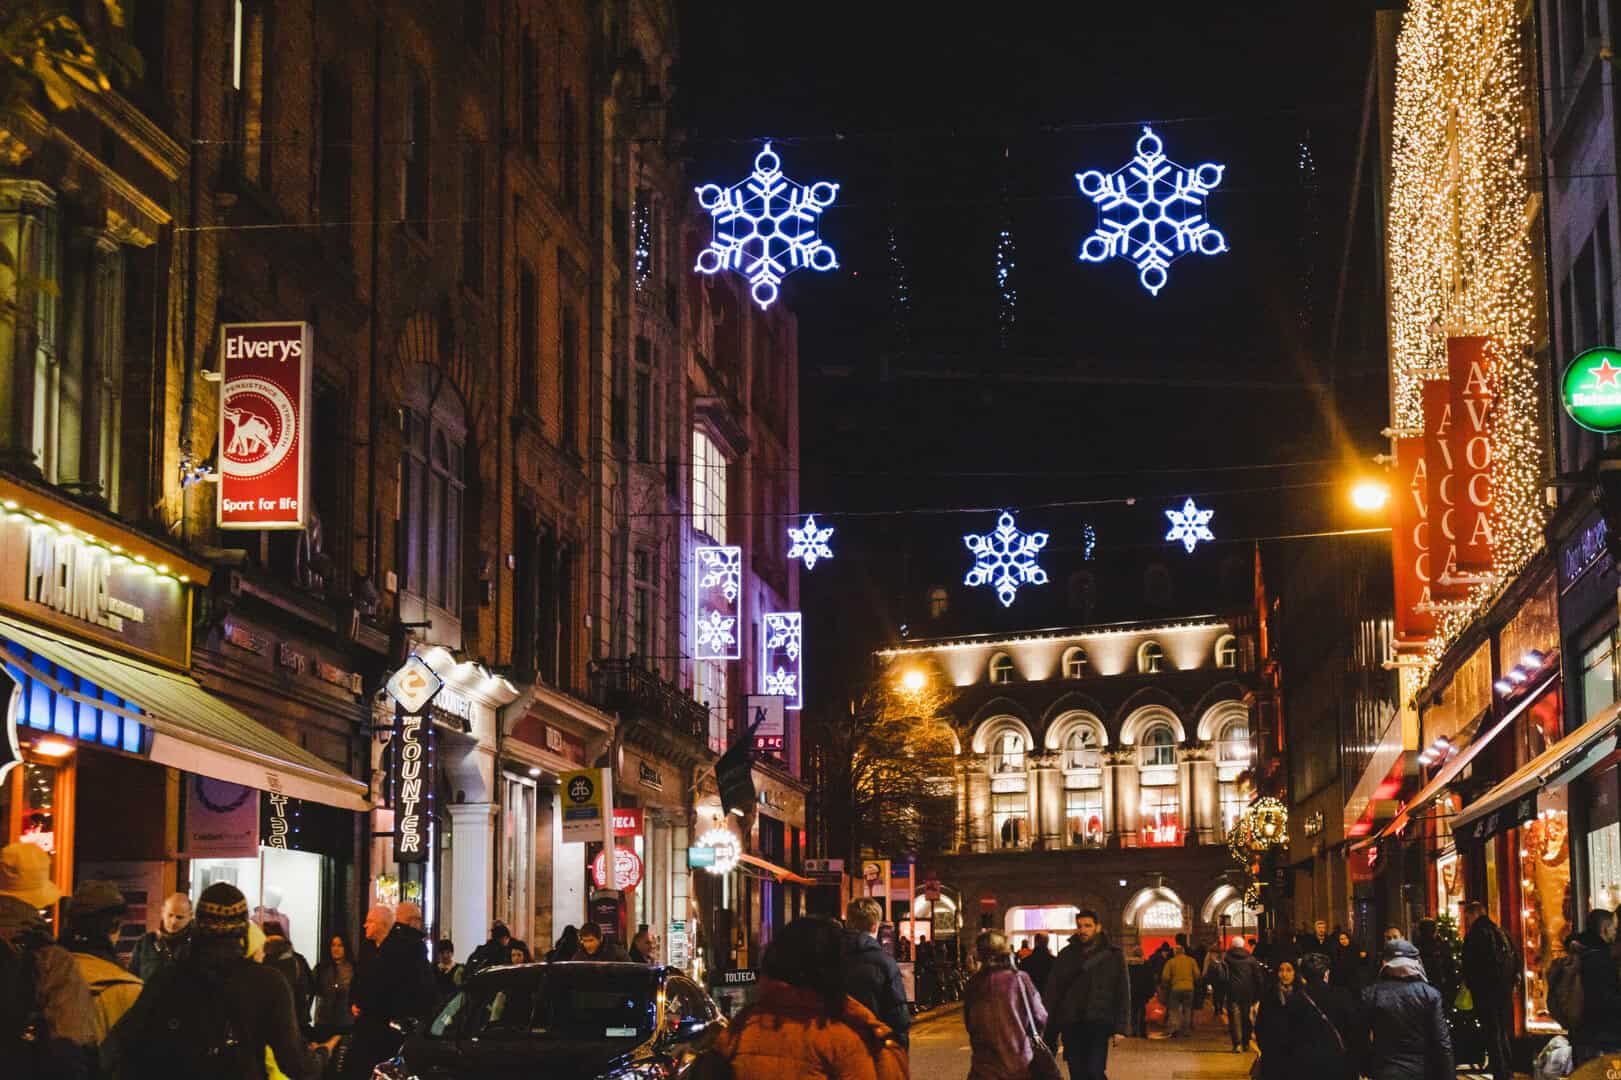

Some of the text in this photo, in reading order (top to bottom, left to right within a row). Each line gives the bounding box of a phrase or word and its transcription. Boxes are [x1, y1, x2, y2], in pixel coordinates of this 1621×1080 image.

[226, 335, 301, 362] Elverys
[1462, 361, 1494, 546] AVOCA
[222, 497, 297, 513] Sport for life
[400, 723, 421, 852] COUNTER
[724, 971, 756, 983] TOLTECA
